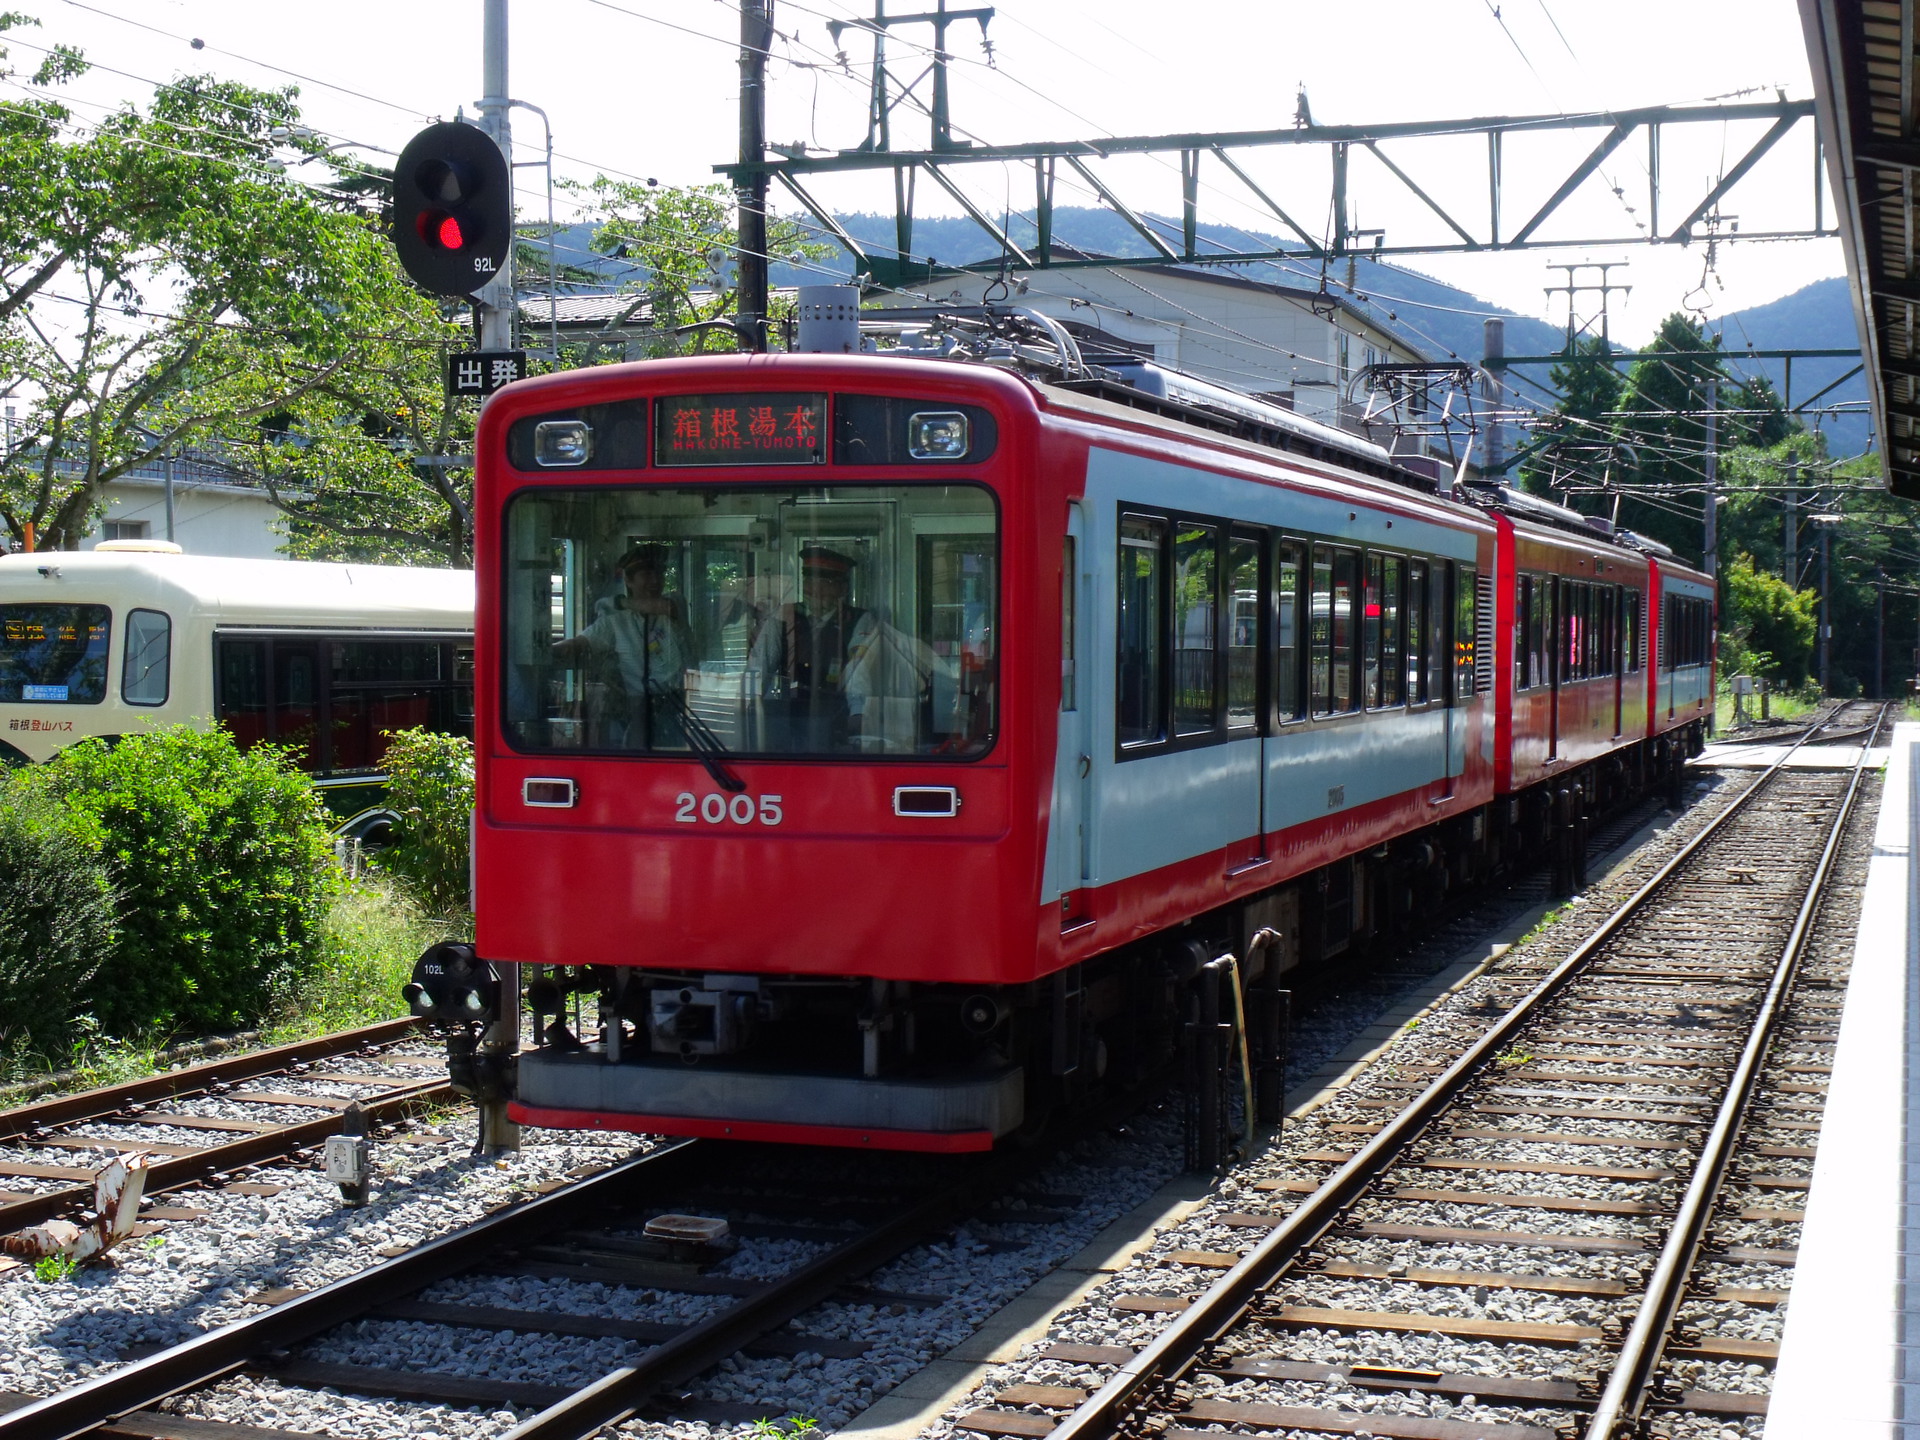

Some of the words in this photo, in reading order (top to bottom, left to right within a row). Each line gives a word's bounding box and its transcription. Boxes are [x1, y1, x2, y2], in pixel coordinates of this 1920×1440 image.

[473, 257, 497, 273] 92L
[457, 359, 519, 390] 出発
[672, 405, 817, 439] 箱根湯本
[672, 435, 817, 451] HAKONE-YUMOTO
[9, 719, 74, 732] 箱根登山バス
[675, 792, 783, 826] 2005
[424, 964, 445, 975] 102L
